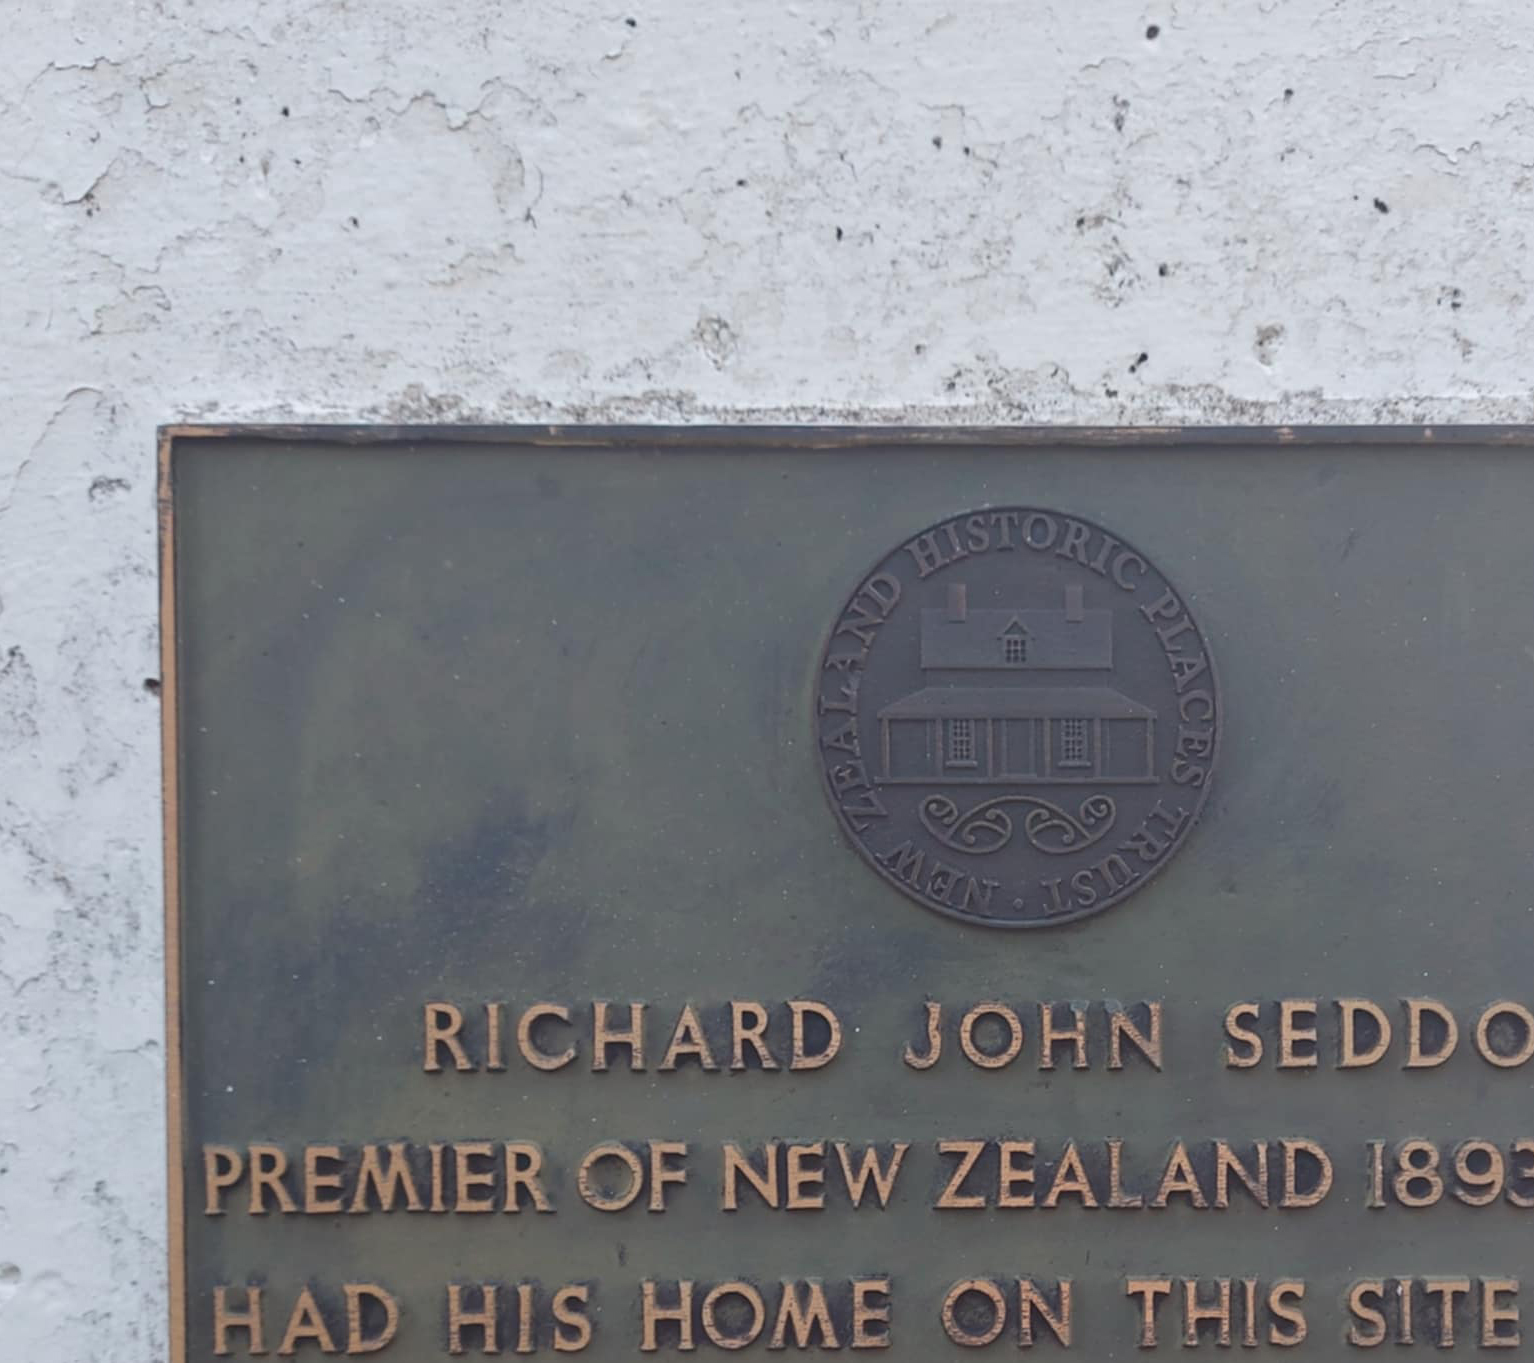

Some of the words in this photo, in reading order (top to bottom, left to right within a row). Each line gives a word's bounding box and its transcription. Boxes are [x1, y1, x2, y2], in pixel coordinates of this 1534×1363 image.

[904, 511, 1148, 592] HISTORIC
[820, 572, 902, 831] ZEALAND
[1140, 587, 1216, 789] PLACES
[882, 840, 1001, 917] NEW
[1040, 798, 1190, 915] TRUST
[424, 1000, 842, 1070] RICHARD
[904, 1001, 1162, 1068] JOHN
[203, 1139, 549, 1214] PREMIER
[578, 1139, 687, 1210] OF
[723, 1141, 909, 1209] NEW
[936, 1137, 1333, 1208] ZEALAND
[213, 1283, 398, 1355] HAD
[448, 1284, 591, 1352] HIS
[641, 1276, 889, 1350] HOME
[942, 1276, 1072, 1346] ON
[1126, 1275, 1307, 1346] THIS
[1349, 1274, 1520, 1346] SITE
